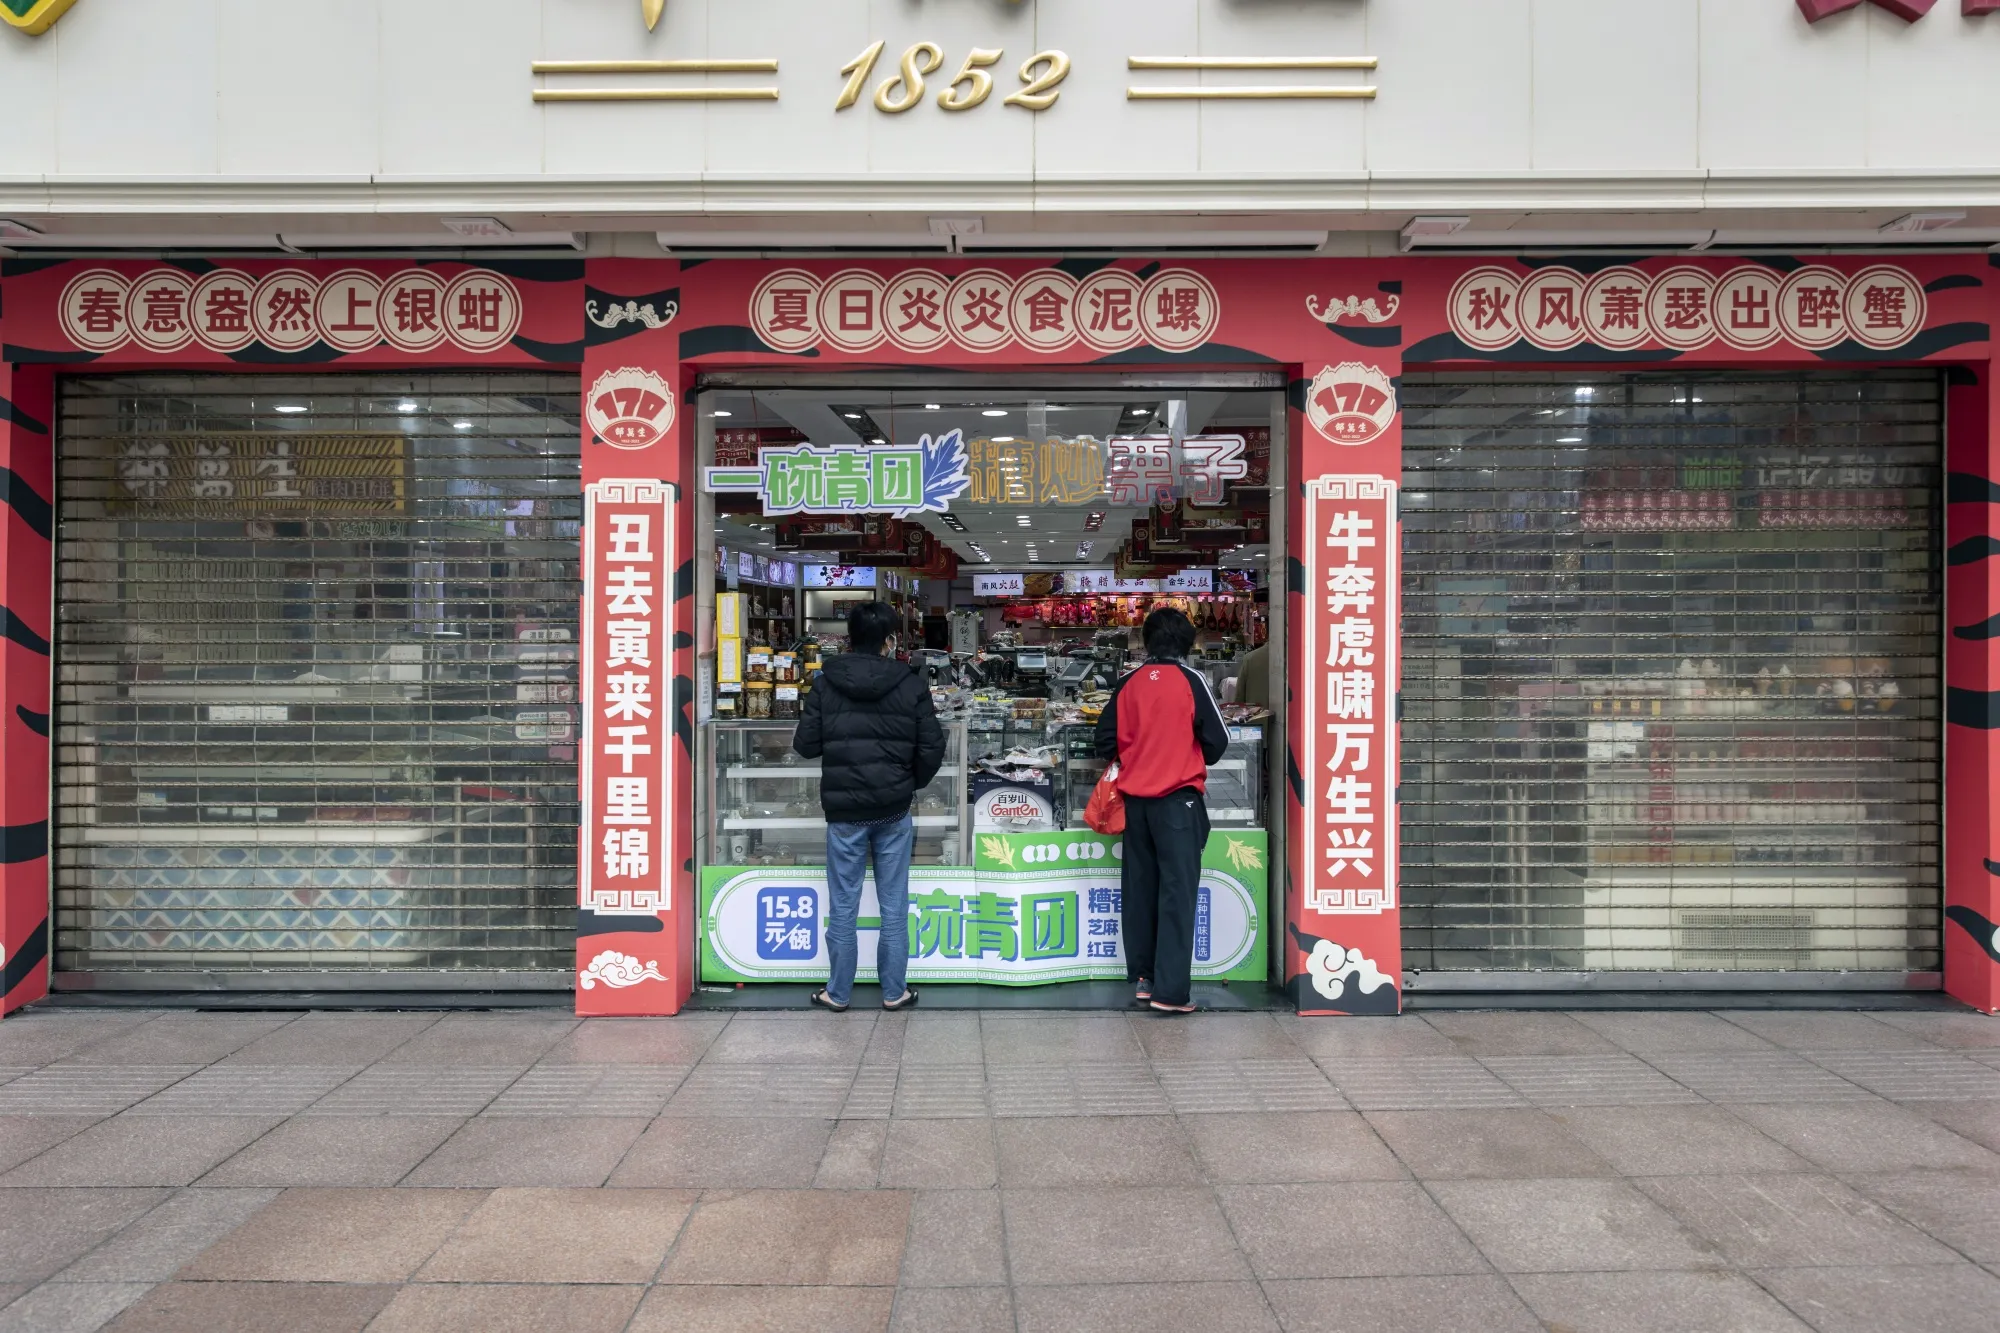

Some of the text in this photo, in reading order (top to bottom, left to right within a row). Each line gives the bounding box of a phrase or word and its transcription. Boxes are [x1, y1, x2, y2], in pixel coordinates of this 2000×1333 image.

[835, 39, 1070, 113] 1852
[77, 286, 503, 333] 春意盎然上银蚶
[768, 286, 1203, 333] 夏日炎炎食泥螺
[1466, 284, 1907, 330] 秋风萧瑟出醉蟹
[594, 387, 667, 421] 170
[1314, 382, 1389, 416] 170
[713, 450, 923, 508] 一碗青团
[970, 437, 1245, 504] 糖炒栗子
[602, 514, 653, 879] 丑去寅来千里锦
[1325, 510, 1376, 878] 牛奔虎啸万生兴
[991, 803, 1039, 816] Ganten
[998, 794, 1027, 804] 百岁山
[761, 895, 813, 918] 15.8
[1088, 919, 1118, 935] 芝麻
[1196, 893, 1208, 957] 五种口味任选
[764, 922, 812, 952] 元/碗
[1087, 941, 1117, 957] 红豆
